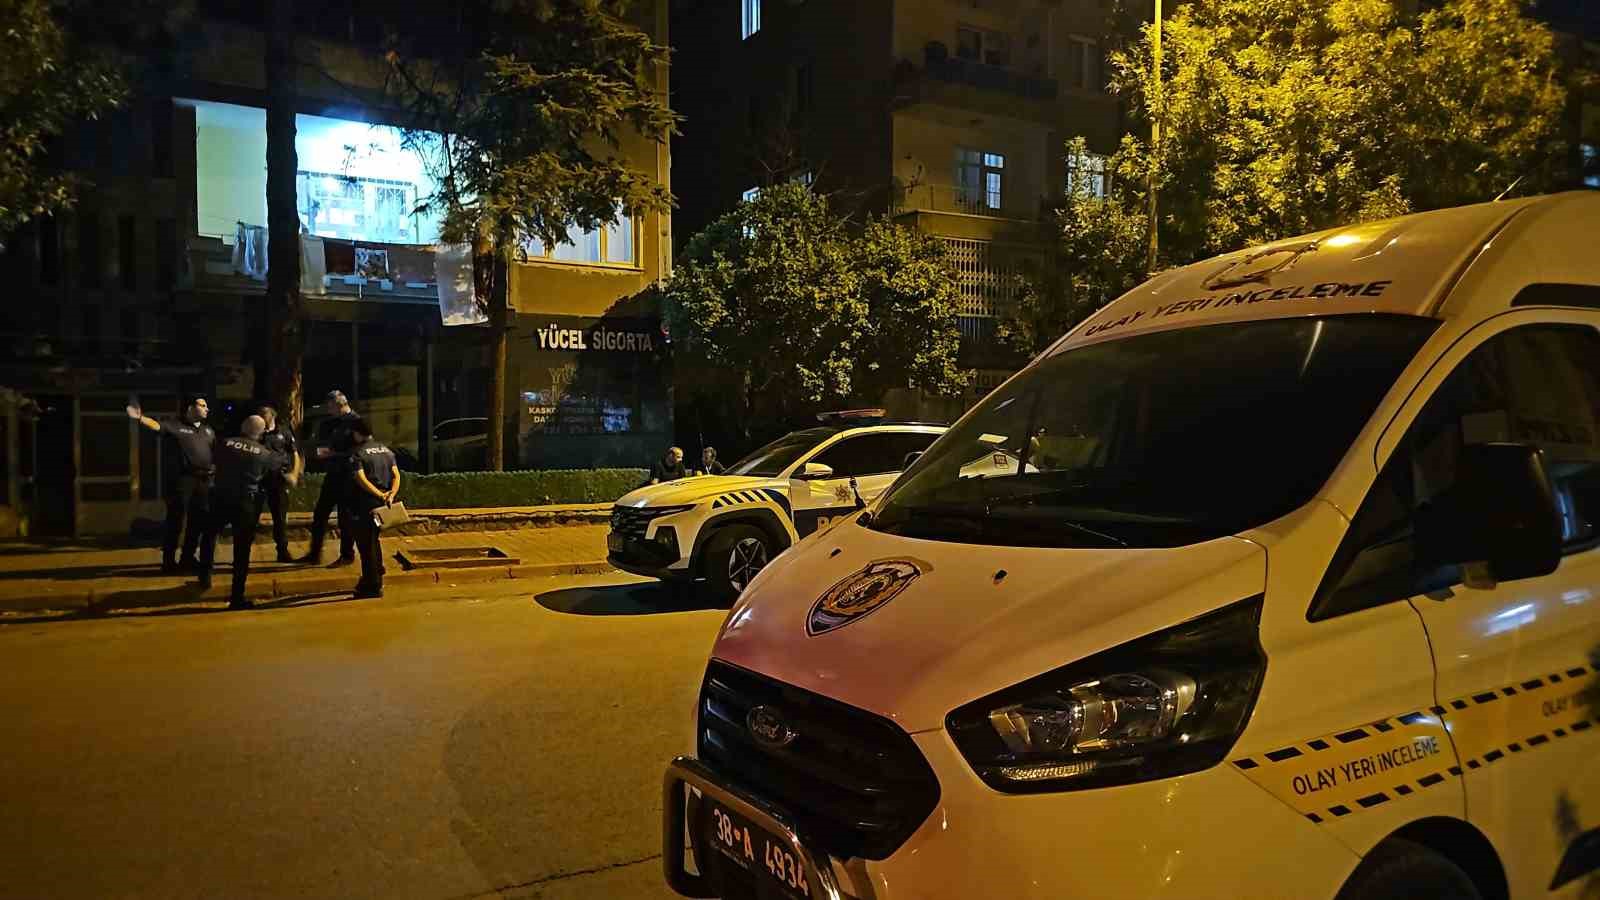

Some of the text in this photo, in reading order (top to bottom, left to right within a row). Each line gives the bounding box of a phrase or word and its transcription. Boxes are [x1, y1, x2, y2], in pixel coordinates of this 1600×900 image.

[537, 323, 653, 352] YÜCEL SİGORTA
[1293, 767, 1337, 796] OLAY
[713, 808, 809, 897] 38 A 4934
